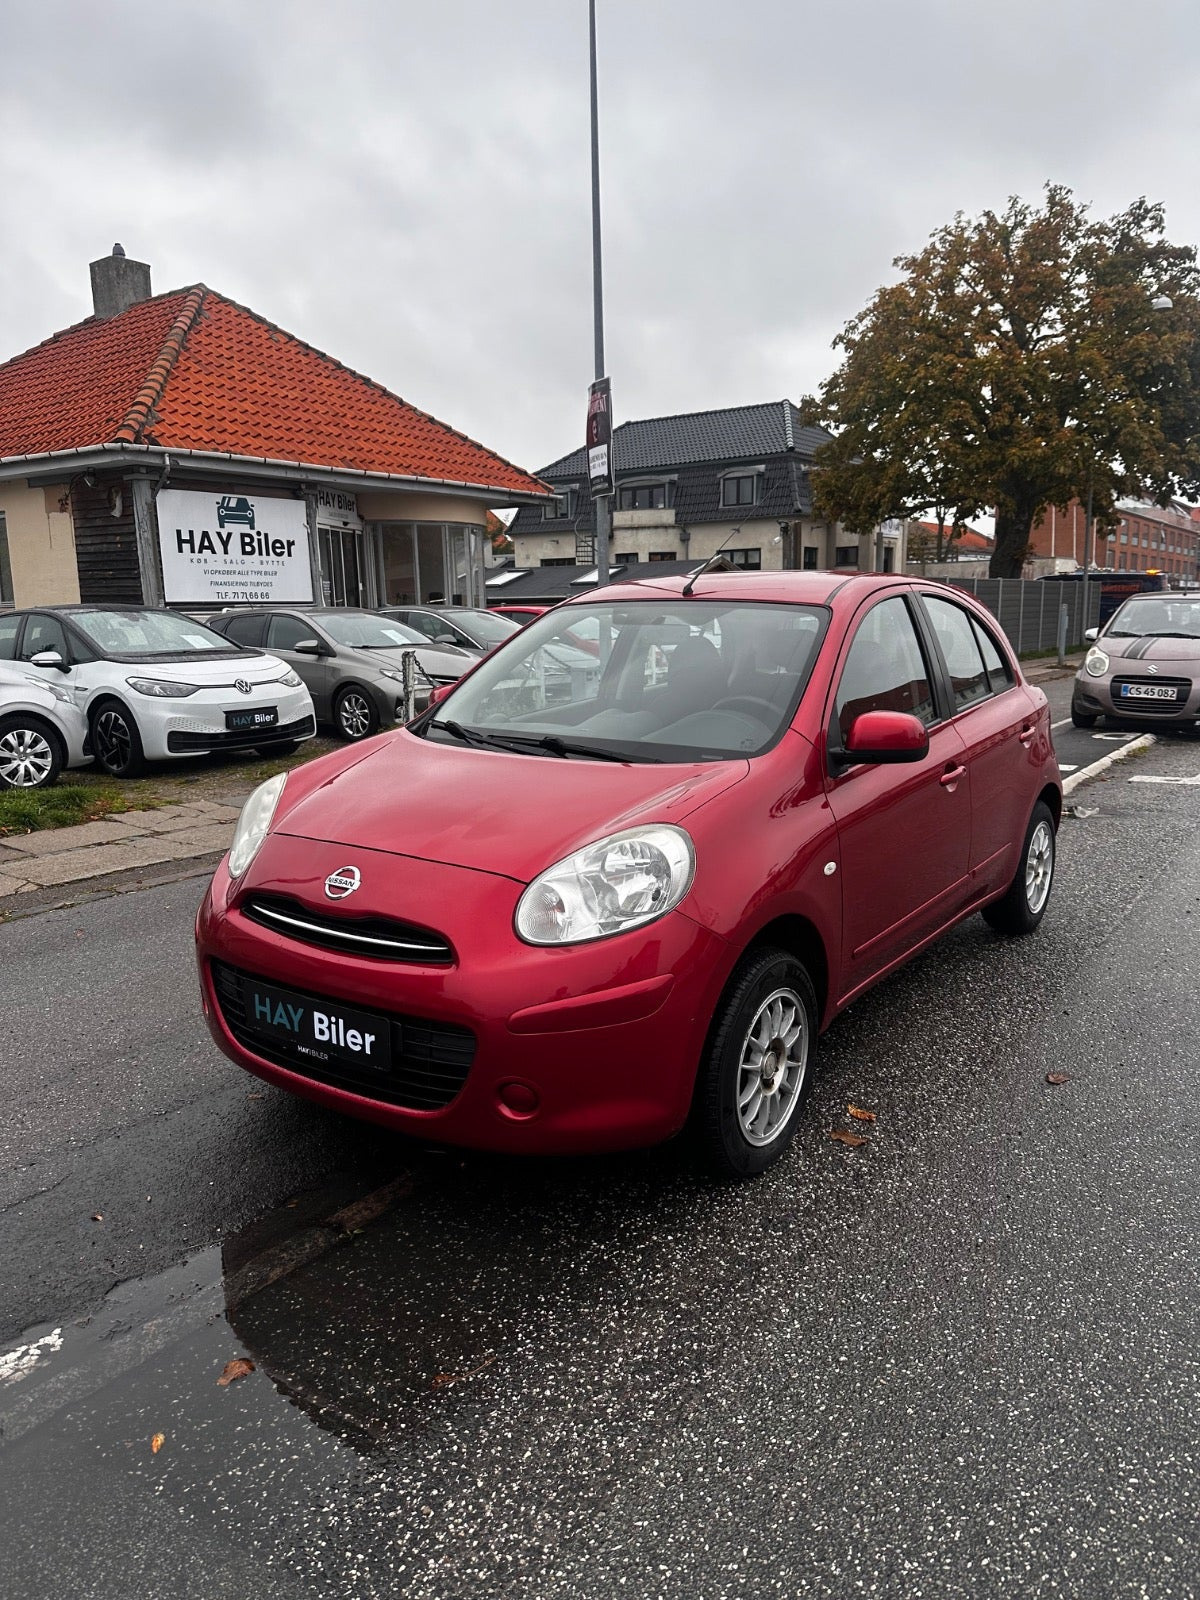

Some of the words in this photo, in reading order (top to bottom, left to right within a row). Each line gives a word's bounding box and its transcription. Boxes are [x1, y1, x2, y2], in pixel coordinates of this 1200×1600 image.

[318, 490, 336, 508] HAY
[337, 494, 355, 512] Biler
[175, 529, 233, 555] HAY
[240, 530, 295, 557] Biler
[216, 591, 231, 599] TLF.
[232, 591, 240, 599] 71
[249, 592, 259, 600] 66
[260, 592, 270, 600] 66
[1129, 686, 1142, 695] CS
[1143, 687, 1156, 697] 45
[1157, 688, 1176, 698] 082
[232, 715, 253, 726] HAY
[254, 713, 274, 723] Biler
[328, 877, 355, 887] NISSAN
[254, 993, 304, 1033] HAY
[313, 1011, 376, 1055] Biler
